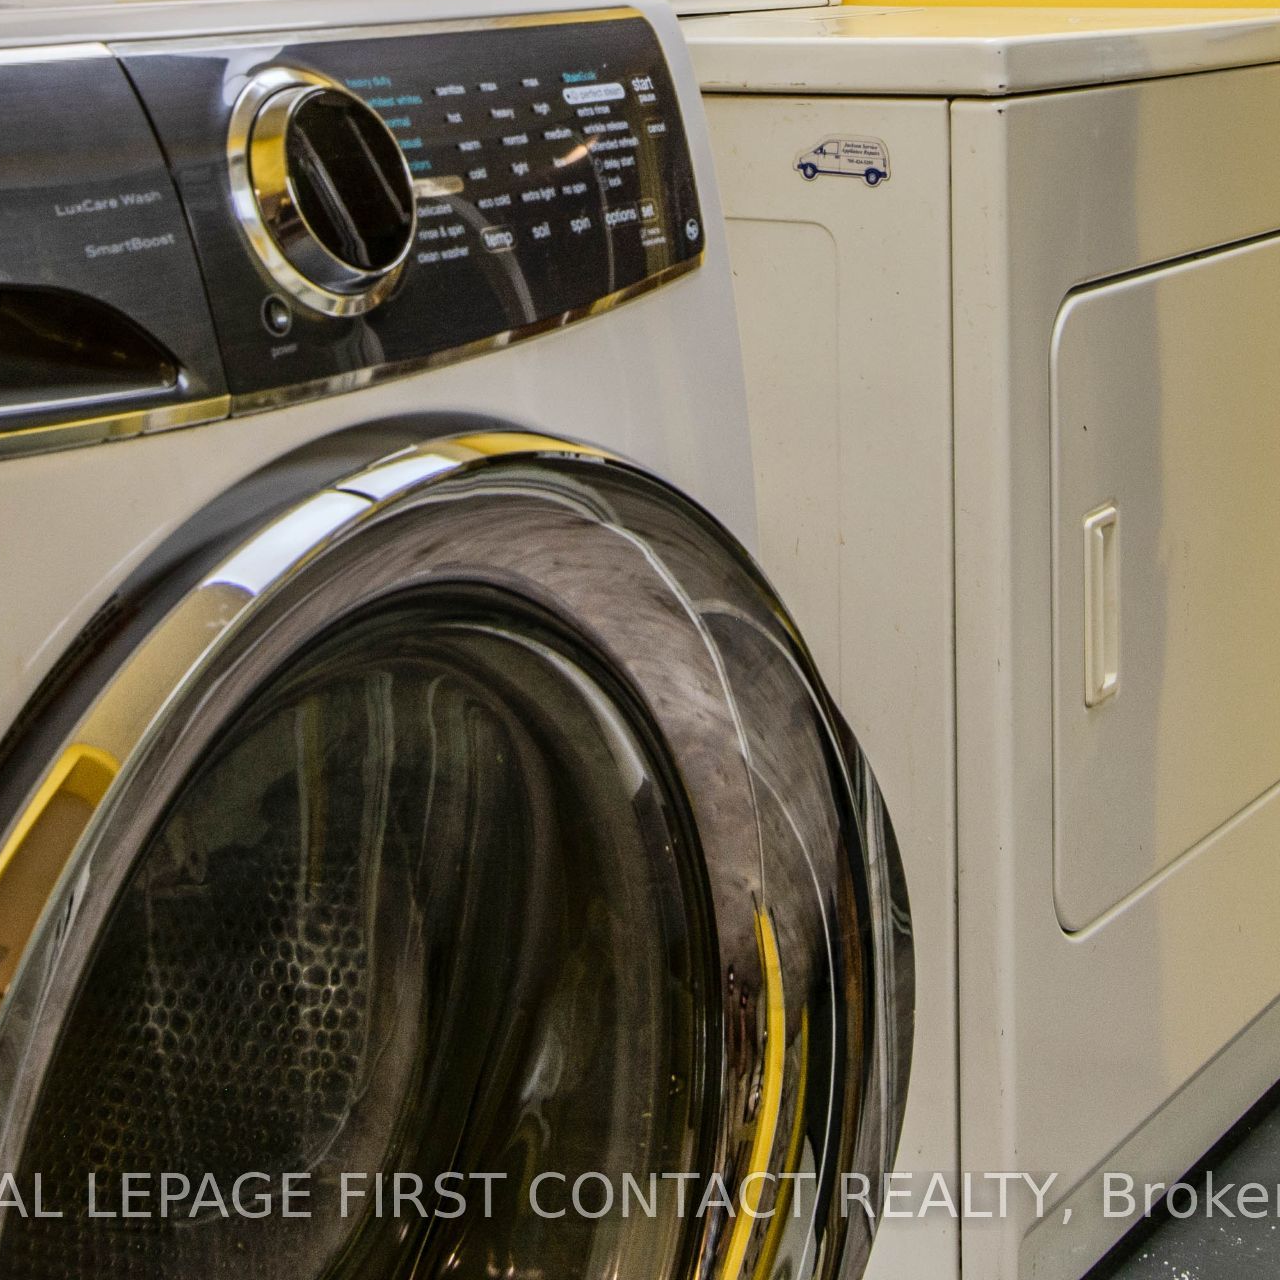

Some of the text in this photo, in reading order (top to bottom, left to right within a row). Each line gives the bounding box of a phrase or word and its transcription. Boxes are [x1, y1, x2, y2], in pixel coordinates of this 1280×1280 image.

[631, 76, 654, 91] start
[55, 189, 162, 217] LuxCare Wash
[570, 216, 592, 235] spin
[605, 207, 637, 226] options
[484, 231, 513, 248] temp
[532, 221, 551, 240] soil
[85, 232, 176, 259] SmartBoost
